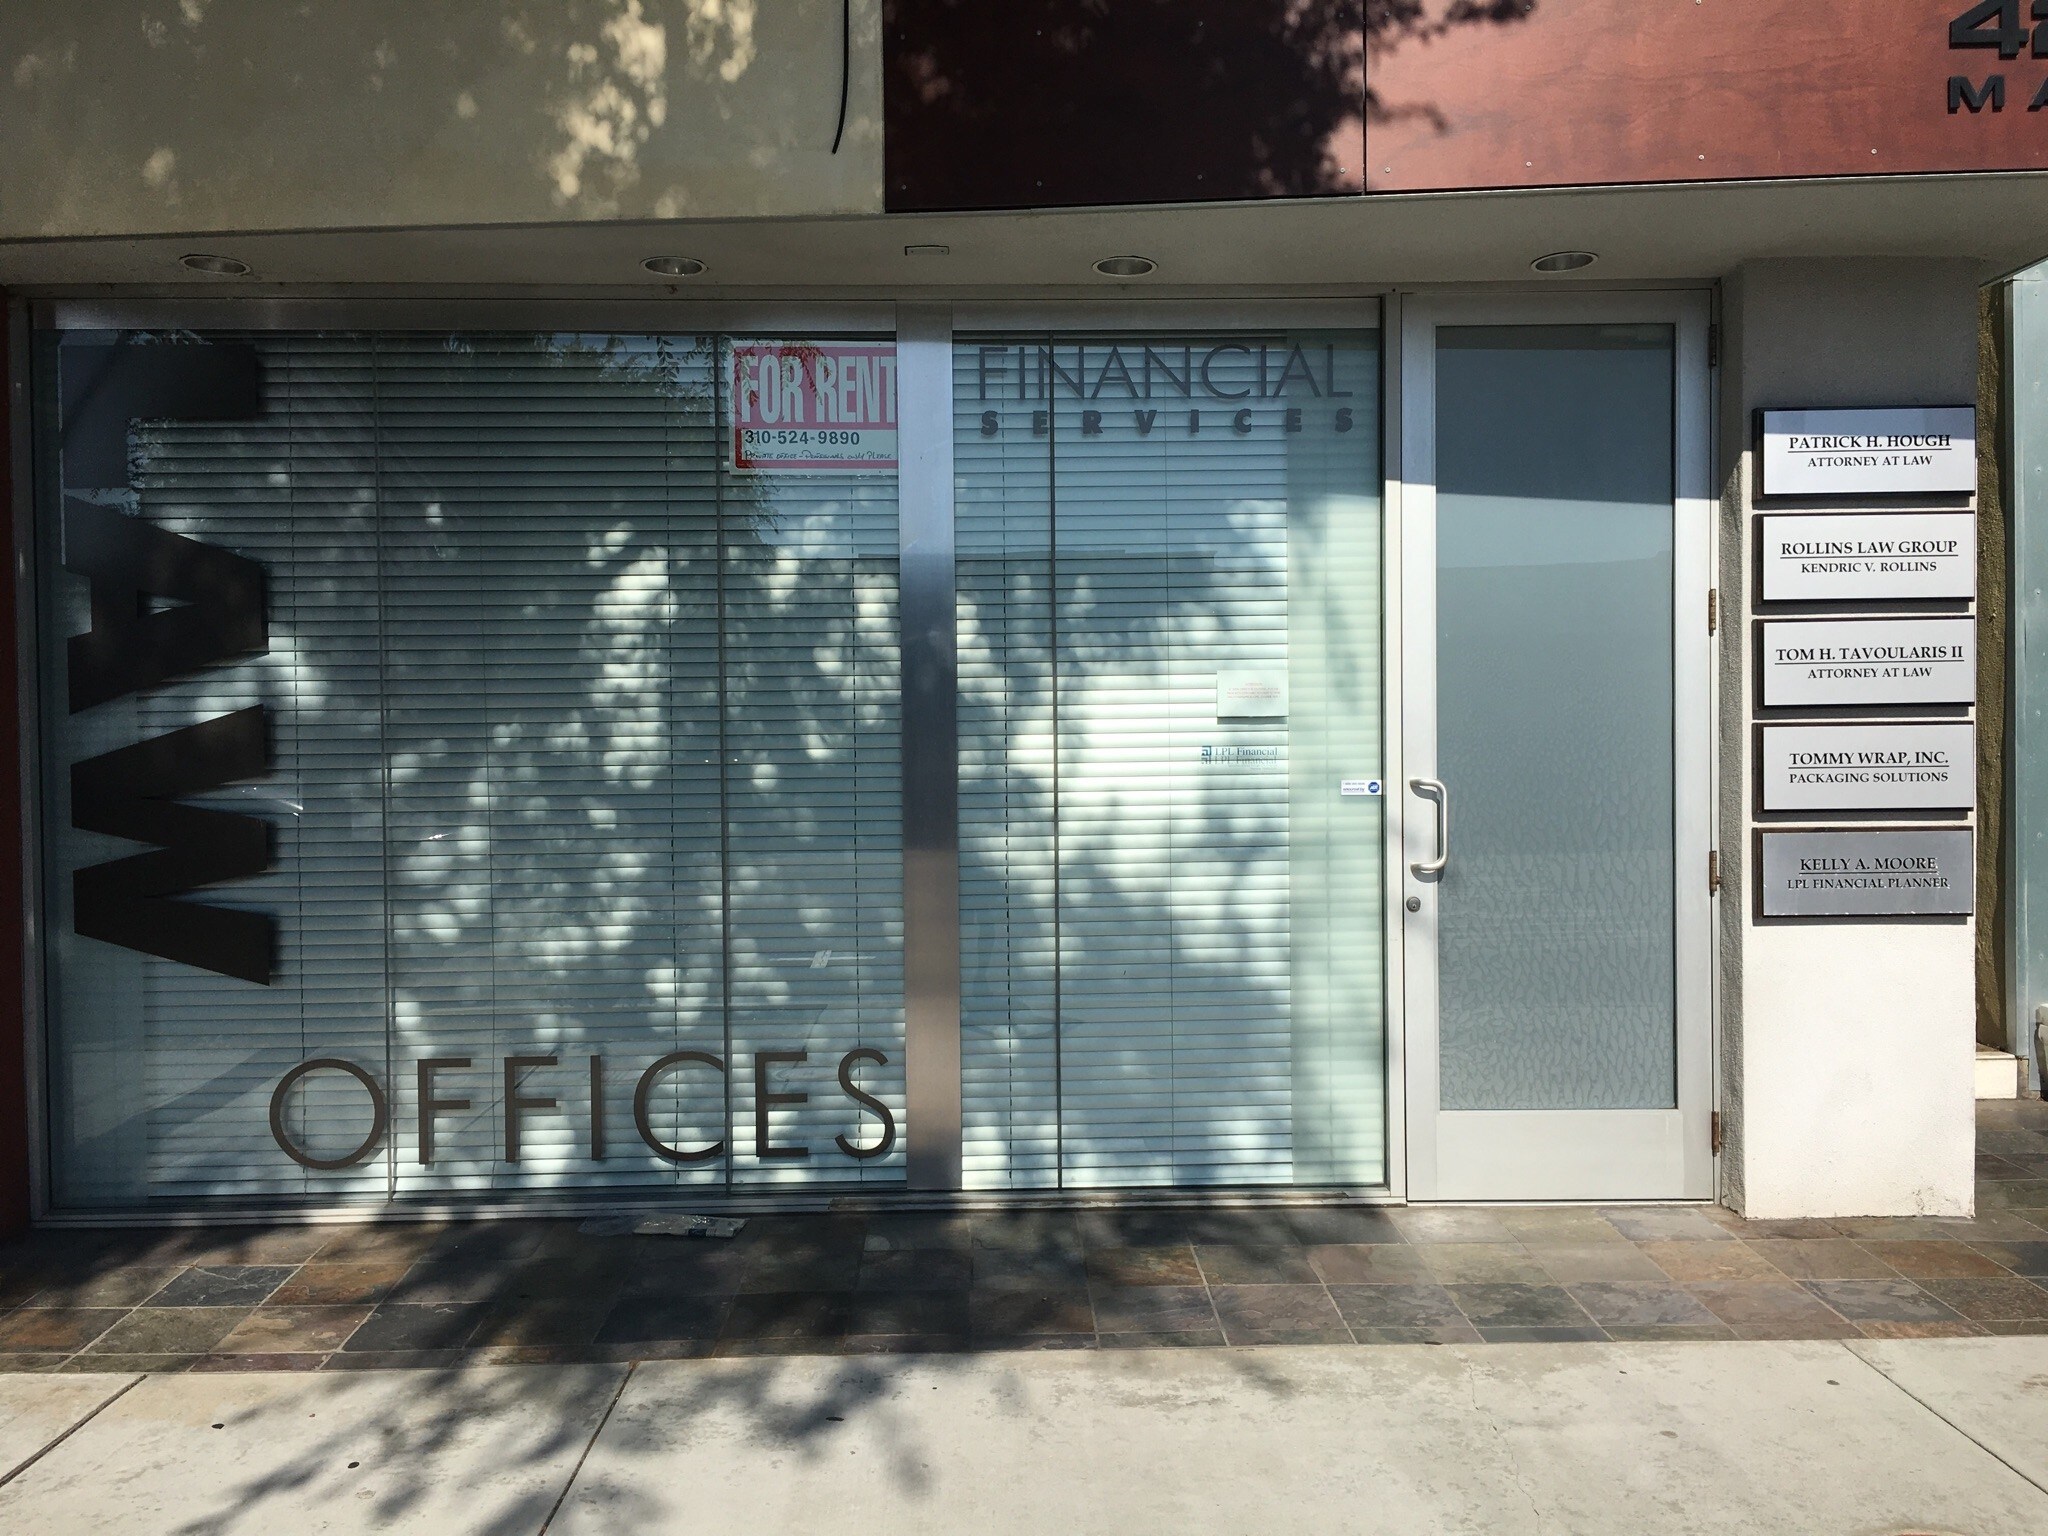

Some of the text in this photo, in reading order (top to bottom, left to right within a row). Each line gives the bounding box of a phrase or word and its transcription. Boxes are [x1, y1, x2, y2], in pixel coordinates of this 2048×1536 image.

[1949, 0, 2048, 60] 4
[979, 343, 1353, 399] FINANCIAL
[741, 355, 896, 423] FOR RENT
[980, 407, 1353, 436] SERVICES
[745, 430, 860, 445] 310-524-9890
[1790, 435, 1950, 449] PATRICK H. HOUGH
[1808, 455, 1932, 467] ATTORNEY AT LAW
[1781, 541, 1957, 554] ROLLINS LAW GROUP
[1801, 562, 1937, 573] KENDRIC V. ROLLINS
[1776, 646, 1963, 661] TOM H. TAVOULARIS II
[61, 343, 271, 986] LAW
[1808, 667, 1932, 679] ATTORNEY AT LAW
[1237, 747, 1278, 755] Financial
[1790, 751, 1948, 766] TOMMY WRAP, INC.
[1790, 773, 1948, 783] PACKAGING SOLUTIONS
[1801, 858, 1937, 870] KELLY A. MOORE
[1788, 878, 1948, 890] LPL FINANCIAL PLANNER
[269, 1047, 895, 1170] OFFICES
